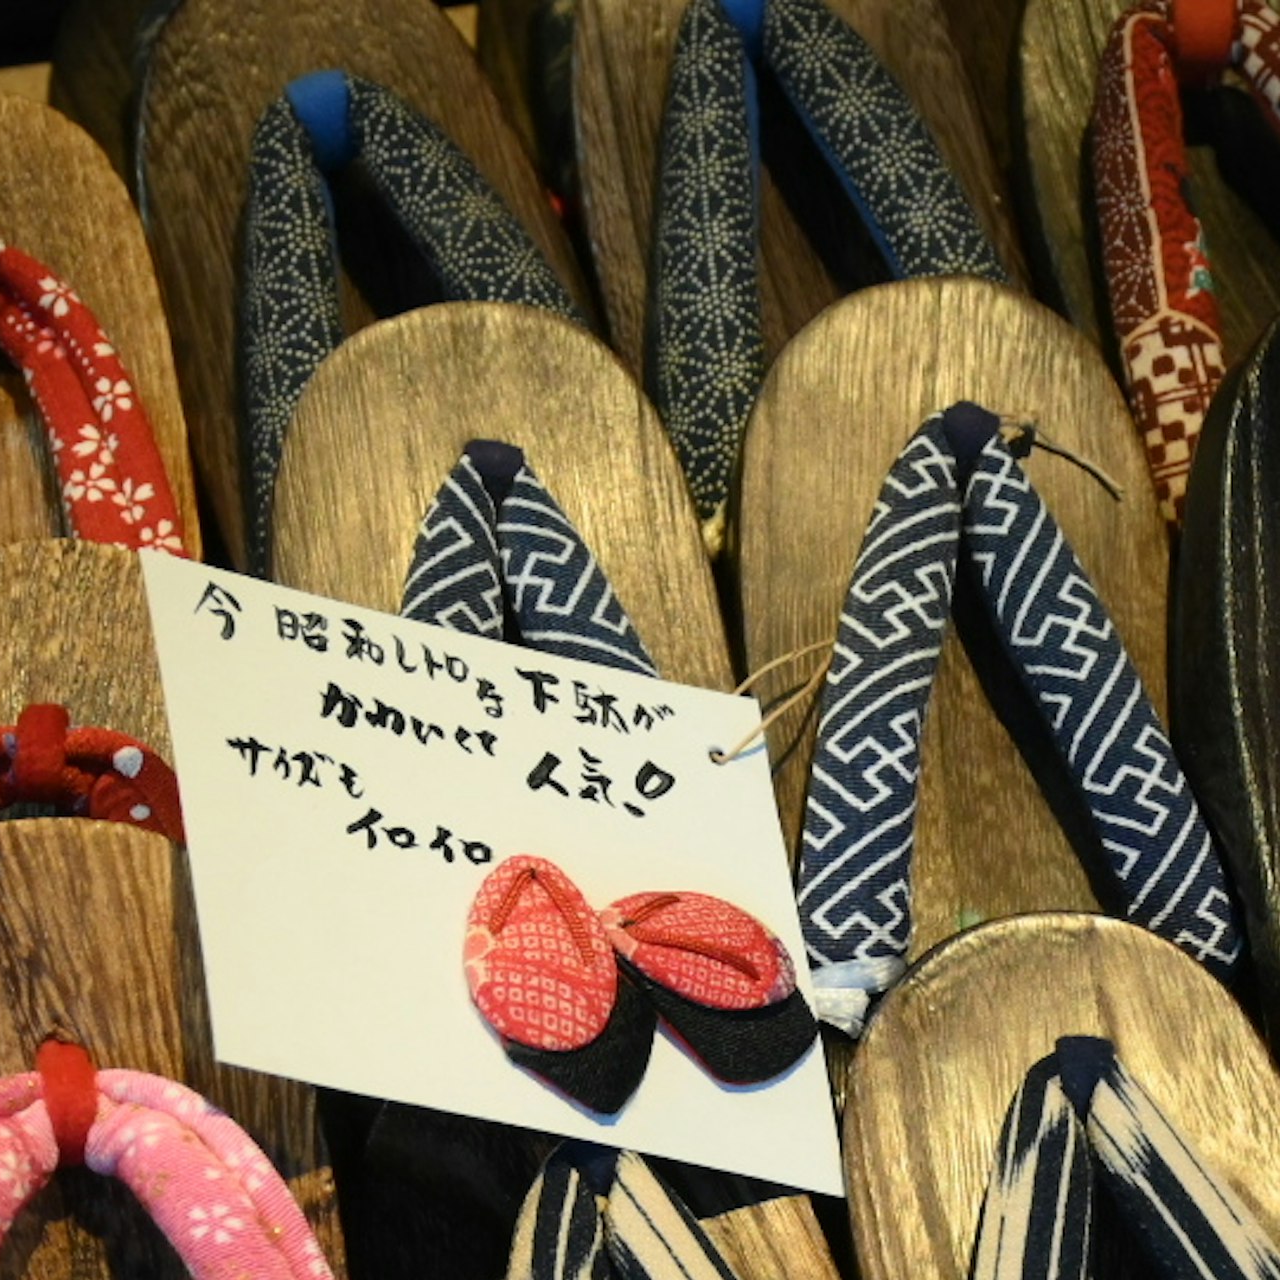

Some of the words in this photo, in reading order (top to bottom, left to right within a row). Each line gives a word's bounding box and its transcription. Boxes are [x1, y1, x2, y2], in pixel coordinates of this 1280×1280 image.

[225, 735, 365, 800] サイズも
[345, 806, 494, 866] イロイロ
